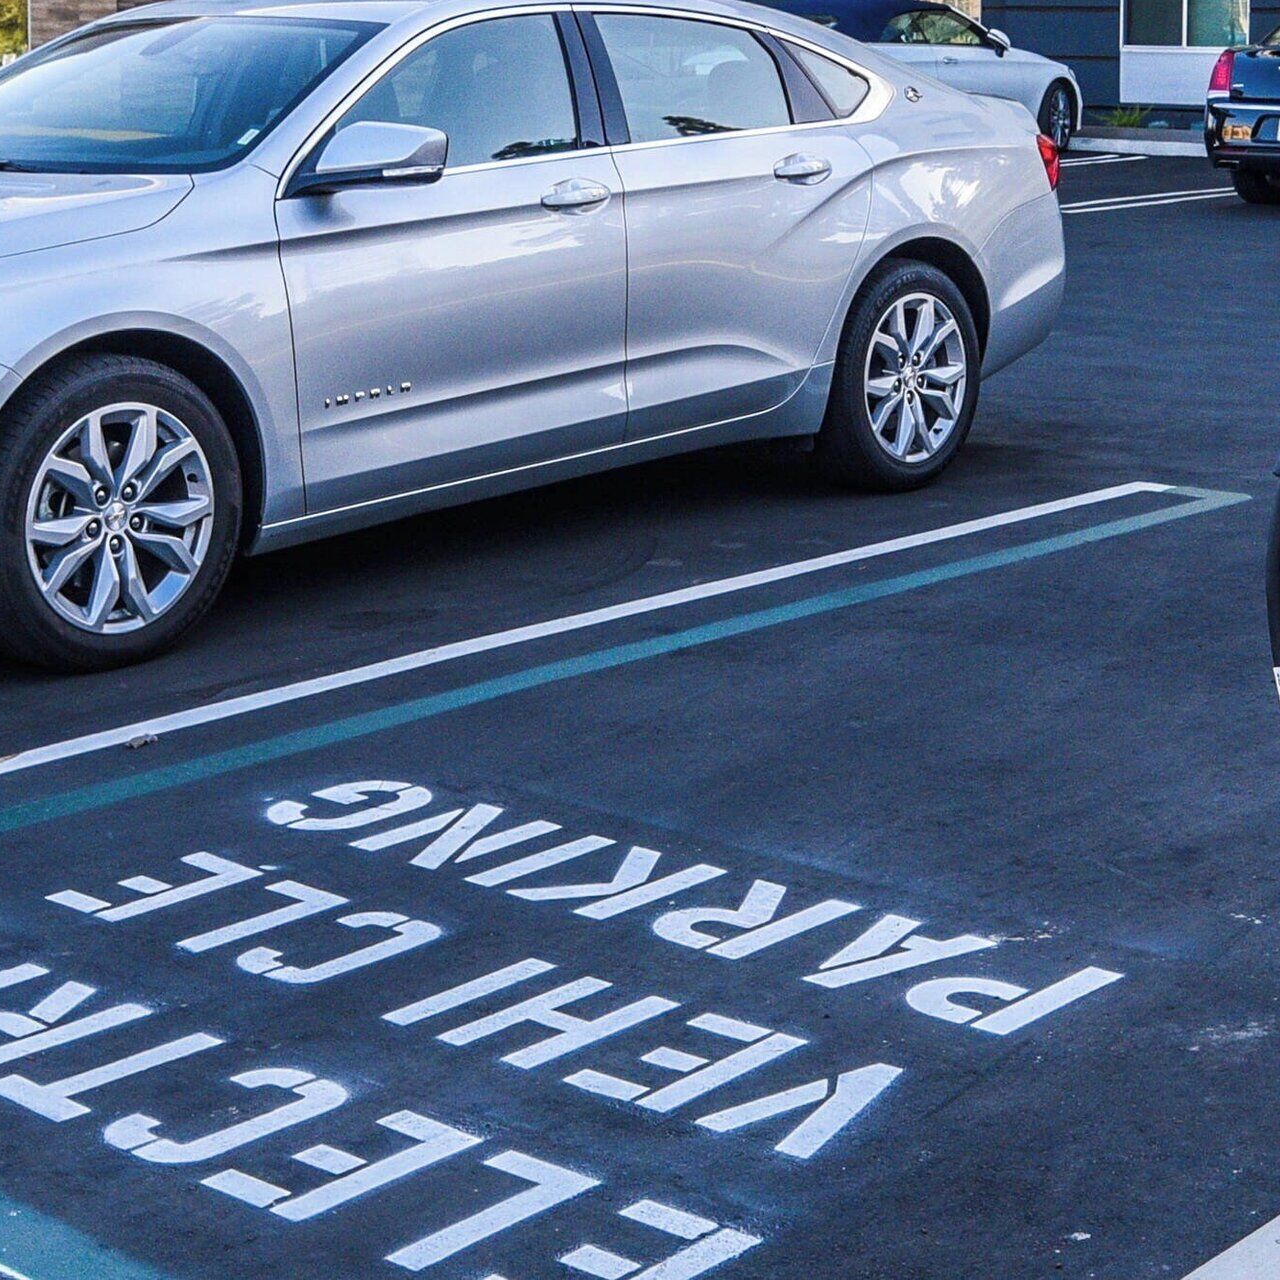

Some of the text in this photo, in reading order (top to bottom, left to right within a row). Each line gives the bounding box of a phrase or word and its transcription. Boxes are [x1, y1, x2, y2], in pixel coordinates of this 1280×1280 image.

[325, 382, 411, 408] IMPALA
[45, 851, 904, 1160] VEHICLE
[265, 780, 1126, 1036] PARKING
